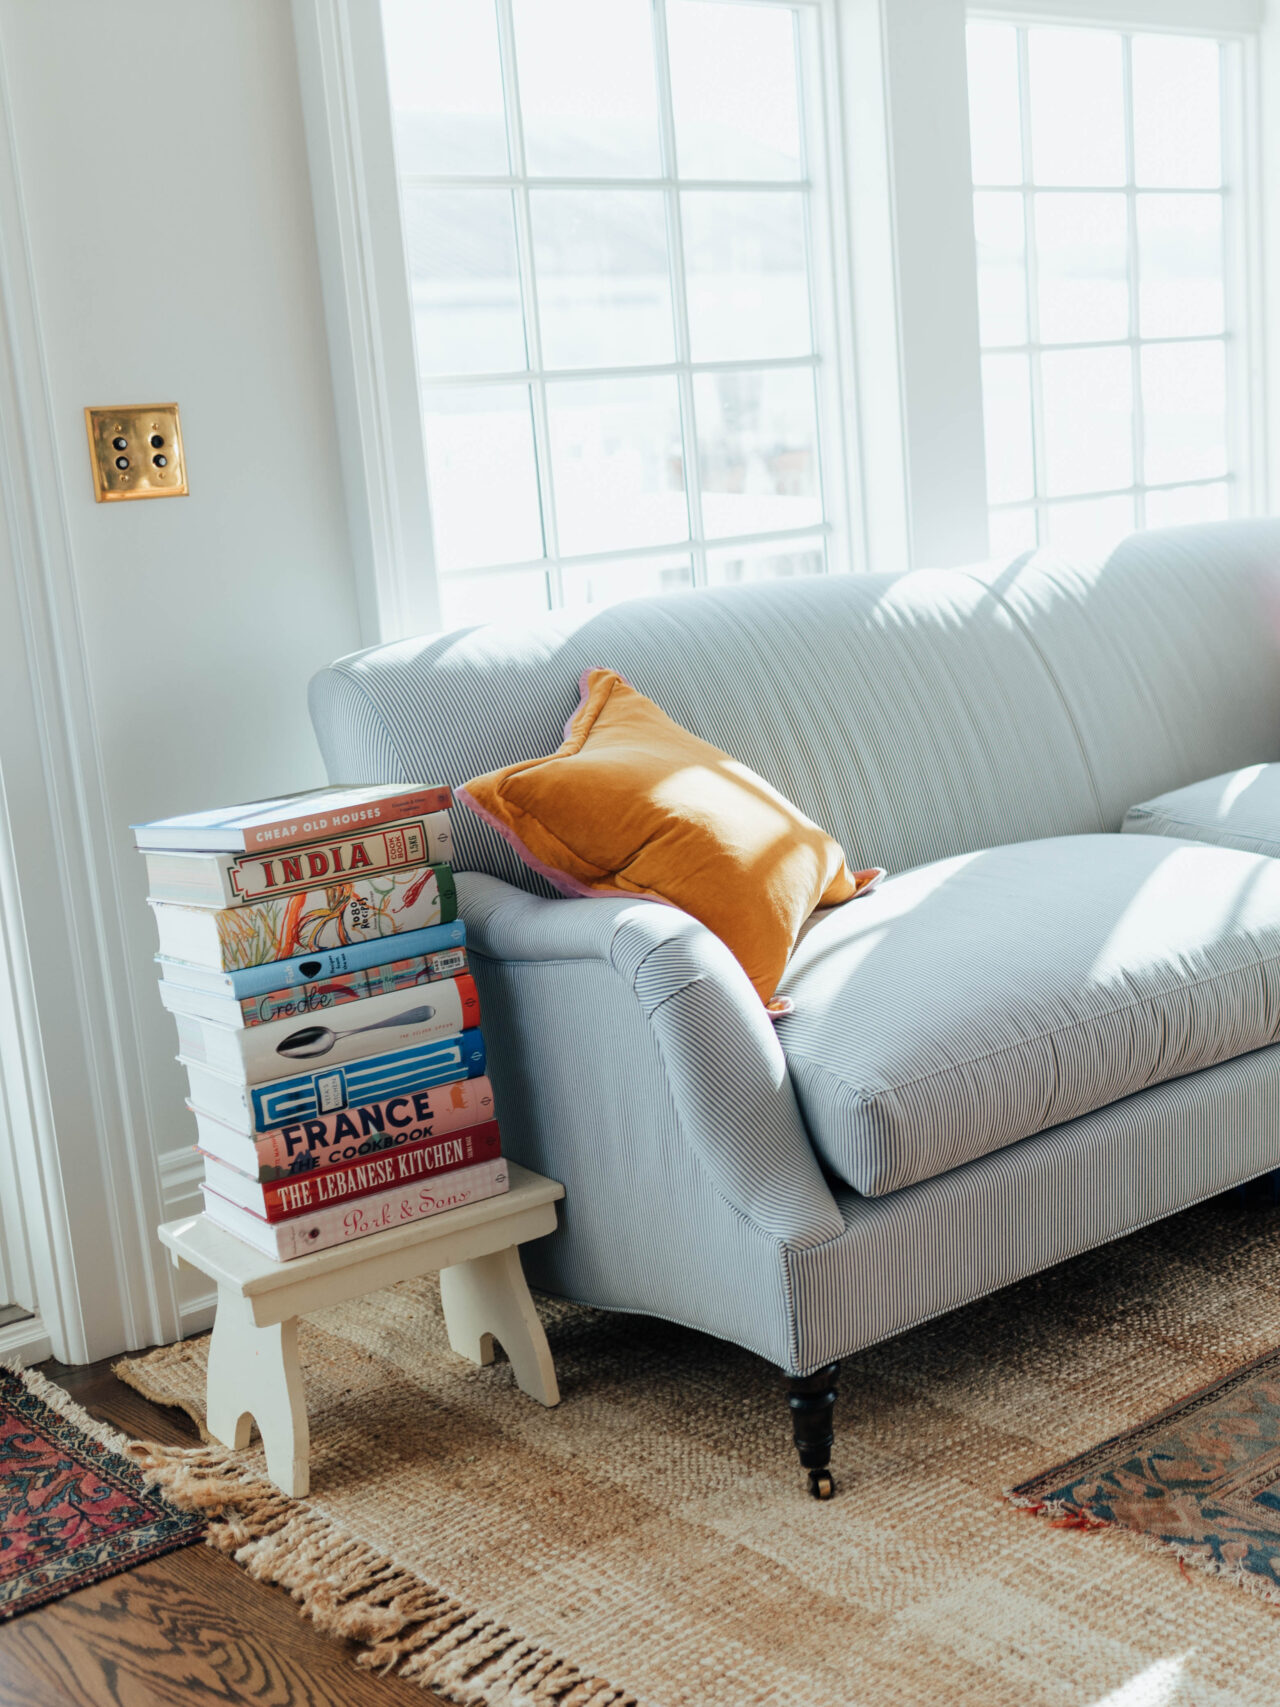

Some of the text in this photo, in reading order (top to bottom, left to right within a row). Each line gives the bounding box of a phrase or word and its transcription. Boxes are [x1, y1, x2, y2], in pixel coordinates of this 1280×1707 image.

[256, 807, 381, 842] CHEAP OLD HOUSES
[395, 835, 403, 859] BOOK
[259, 842, 374, 888] INDIA
[388, 836, 397, 860] COOK
[350, 901, 362, 928] 1080
[281, 1092, 434, 1157] FRANCE
[288, 1155, 320, 1175] THE
[328, 1125, 434, 1163] COOKBOOK
[277, 1181, 313, 1212] THE
[316, 1157, 395, 1202] LEBANESE
[399, 1138, 464, 1177] KITCHEN
[343, 1187, 471, 1237] Pork & Sons
